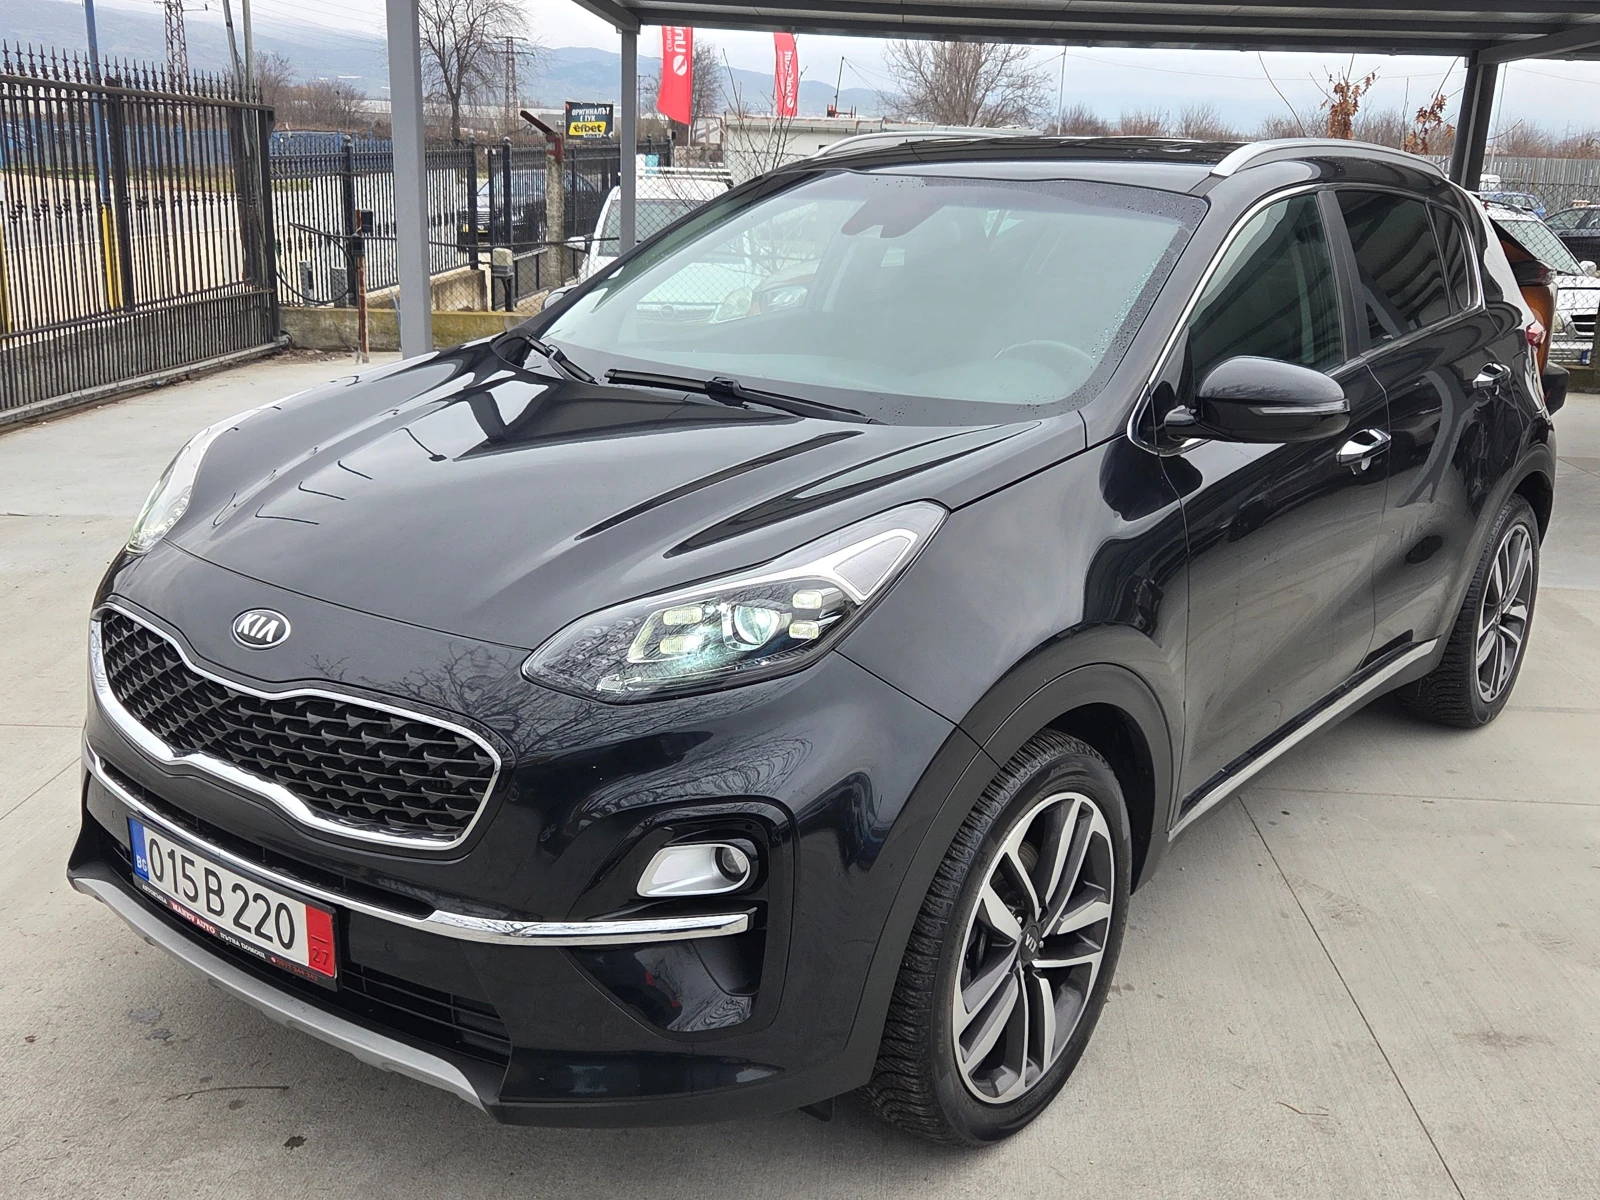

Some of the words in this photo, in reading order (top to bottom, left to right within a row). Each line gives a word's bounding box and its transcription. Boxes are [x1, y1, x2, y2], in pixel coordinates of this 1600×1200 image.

[571, 107, 610, 116] ОРИГИНАЛЪТ
[573, 124, 602, 133] efbet
[236, 613, 280, 643] KIA
[136, 854, 148, 872] BG
[311, 946, 329, 966] 27
